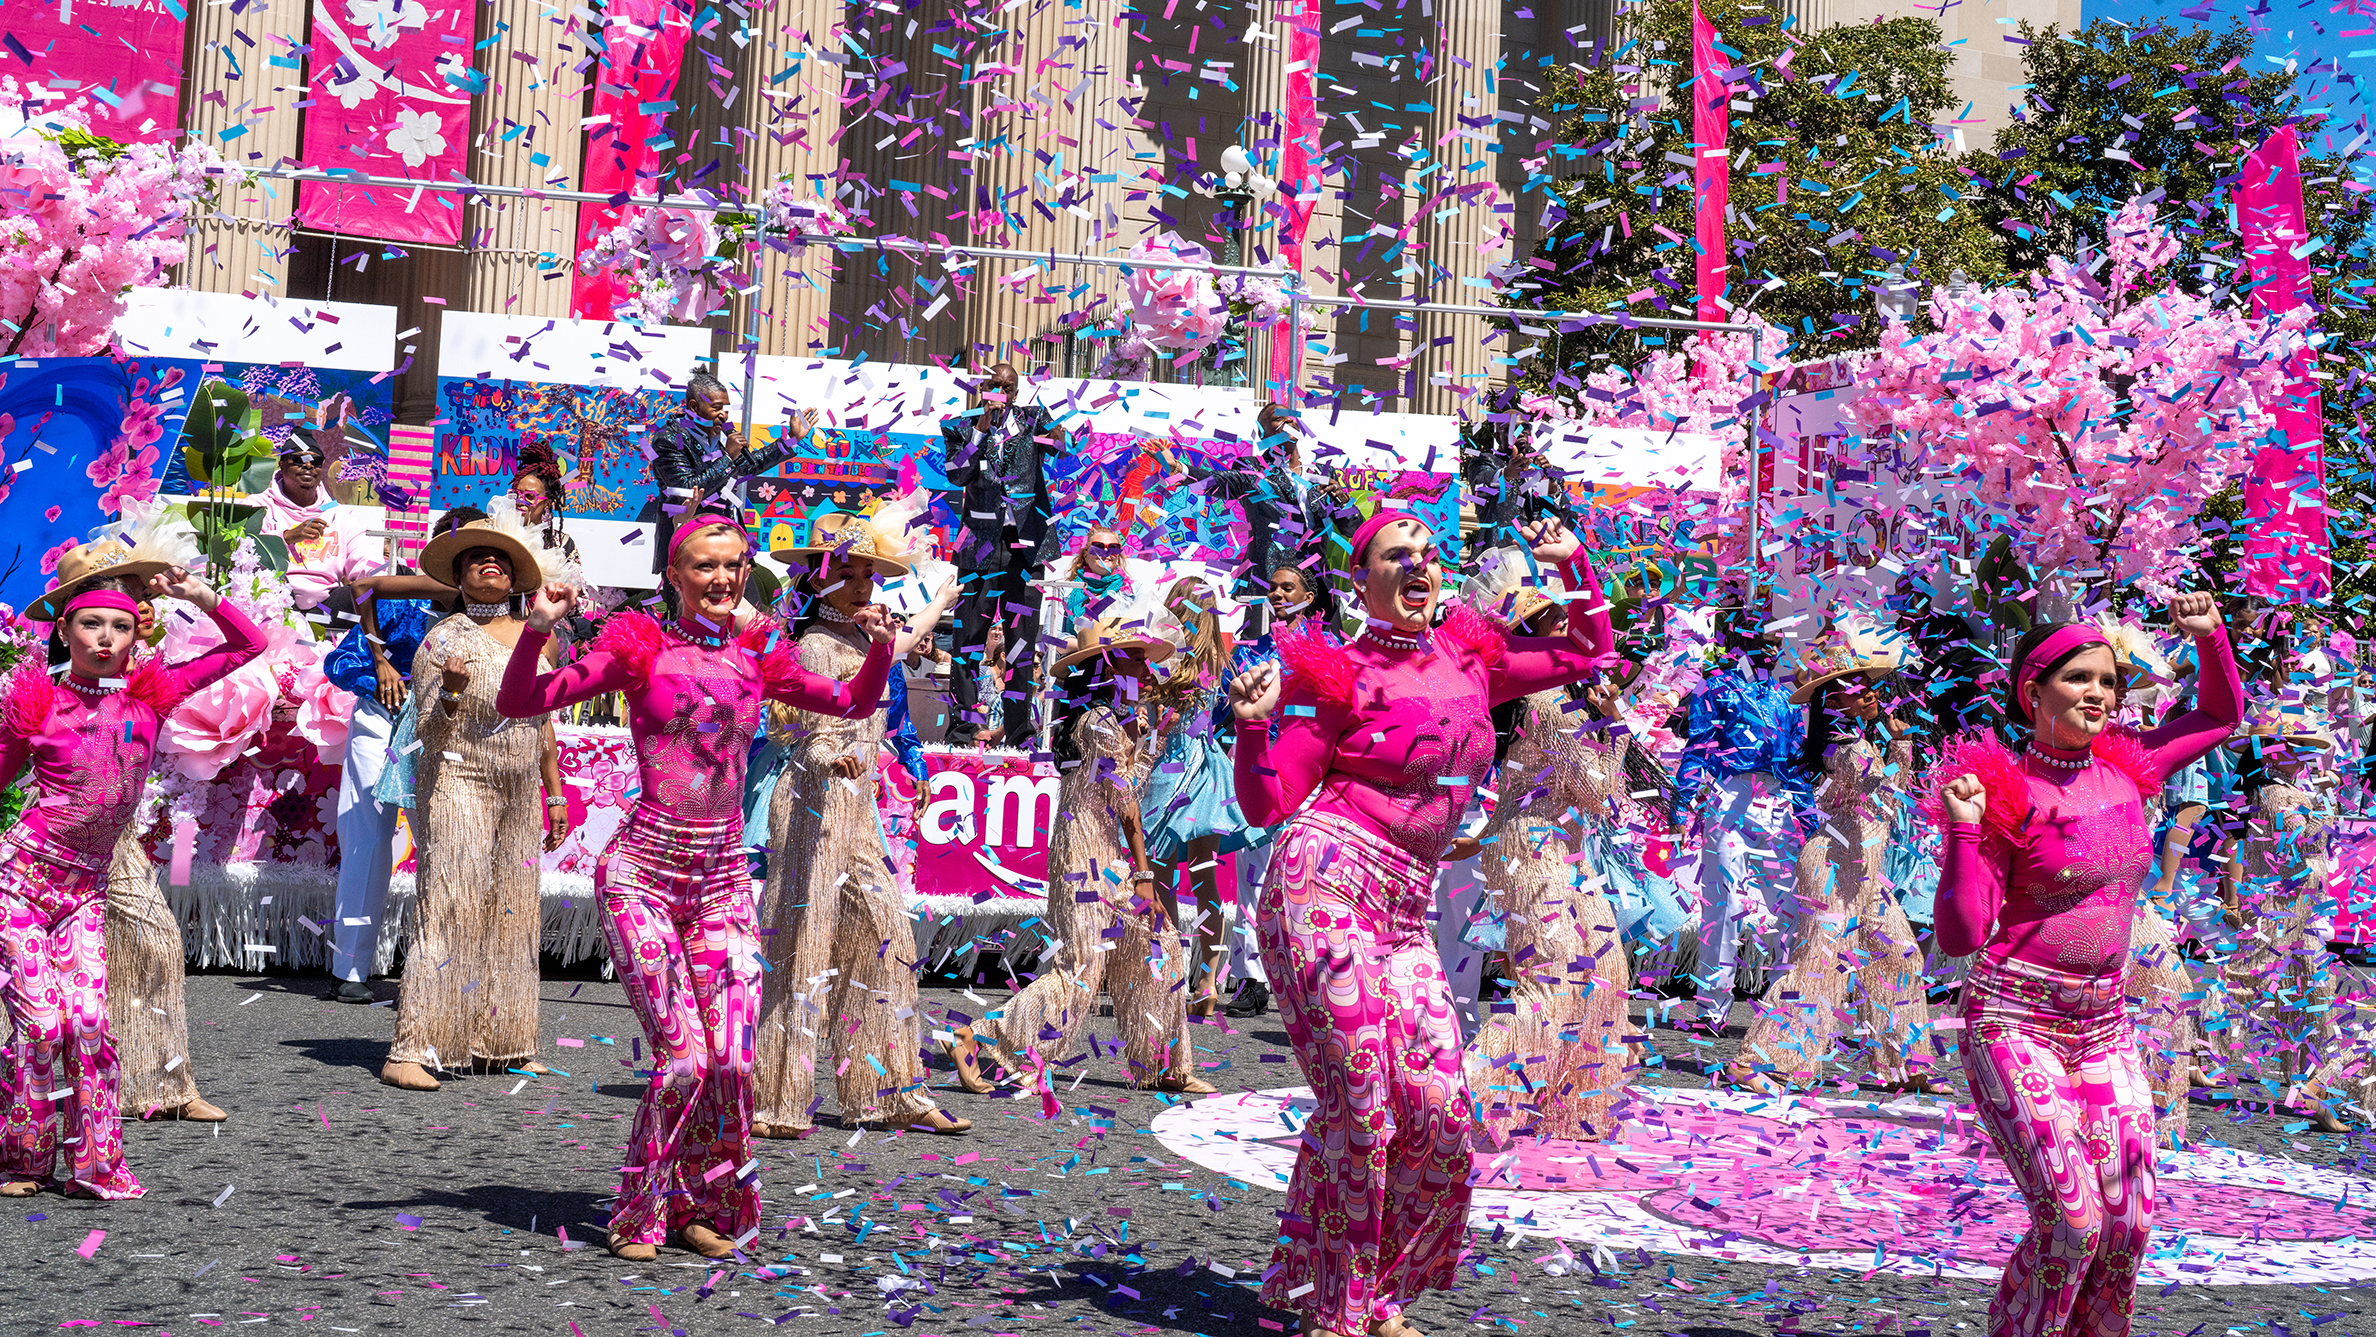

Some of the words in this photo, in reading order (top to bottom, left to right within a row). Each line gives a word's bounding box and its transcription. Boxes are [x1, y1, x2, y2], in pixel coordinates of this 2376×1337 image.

[75, 0, 166, 14] SVAL
[441, 433, 569, 477] KINDNS
[828, 464, 849, 476] THE
[850, 464, 878, 478] BLO
[572, 497, 619, 515] THINKRS
[920, 771, 1061, 848] am
